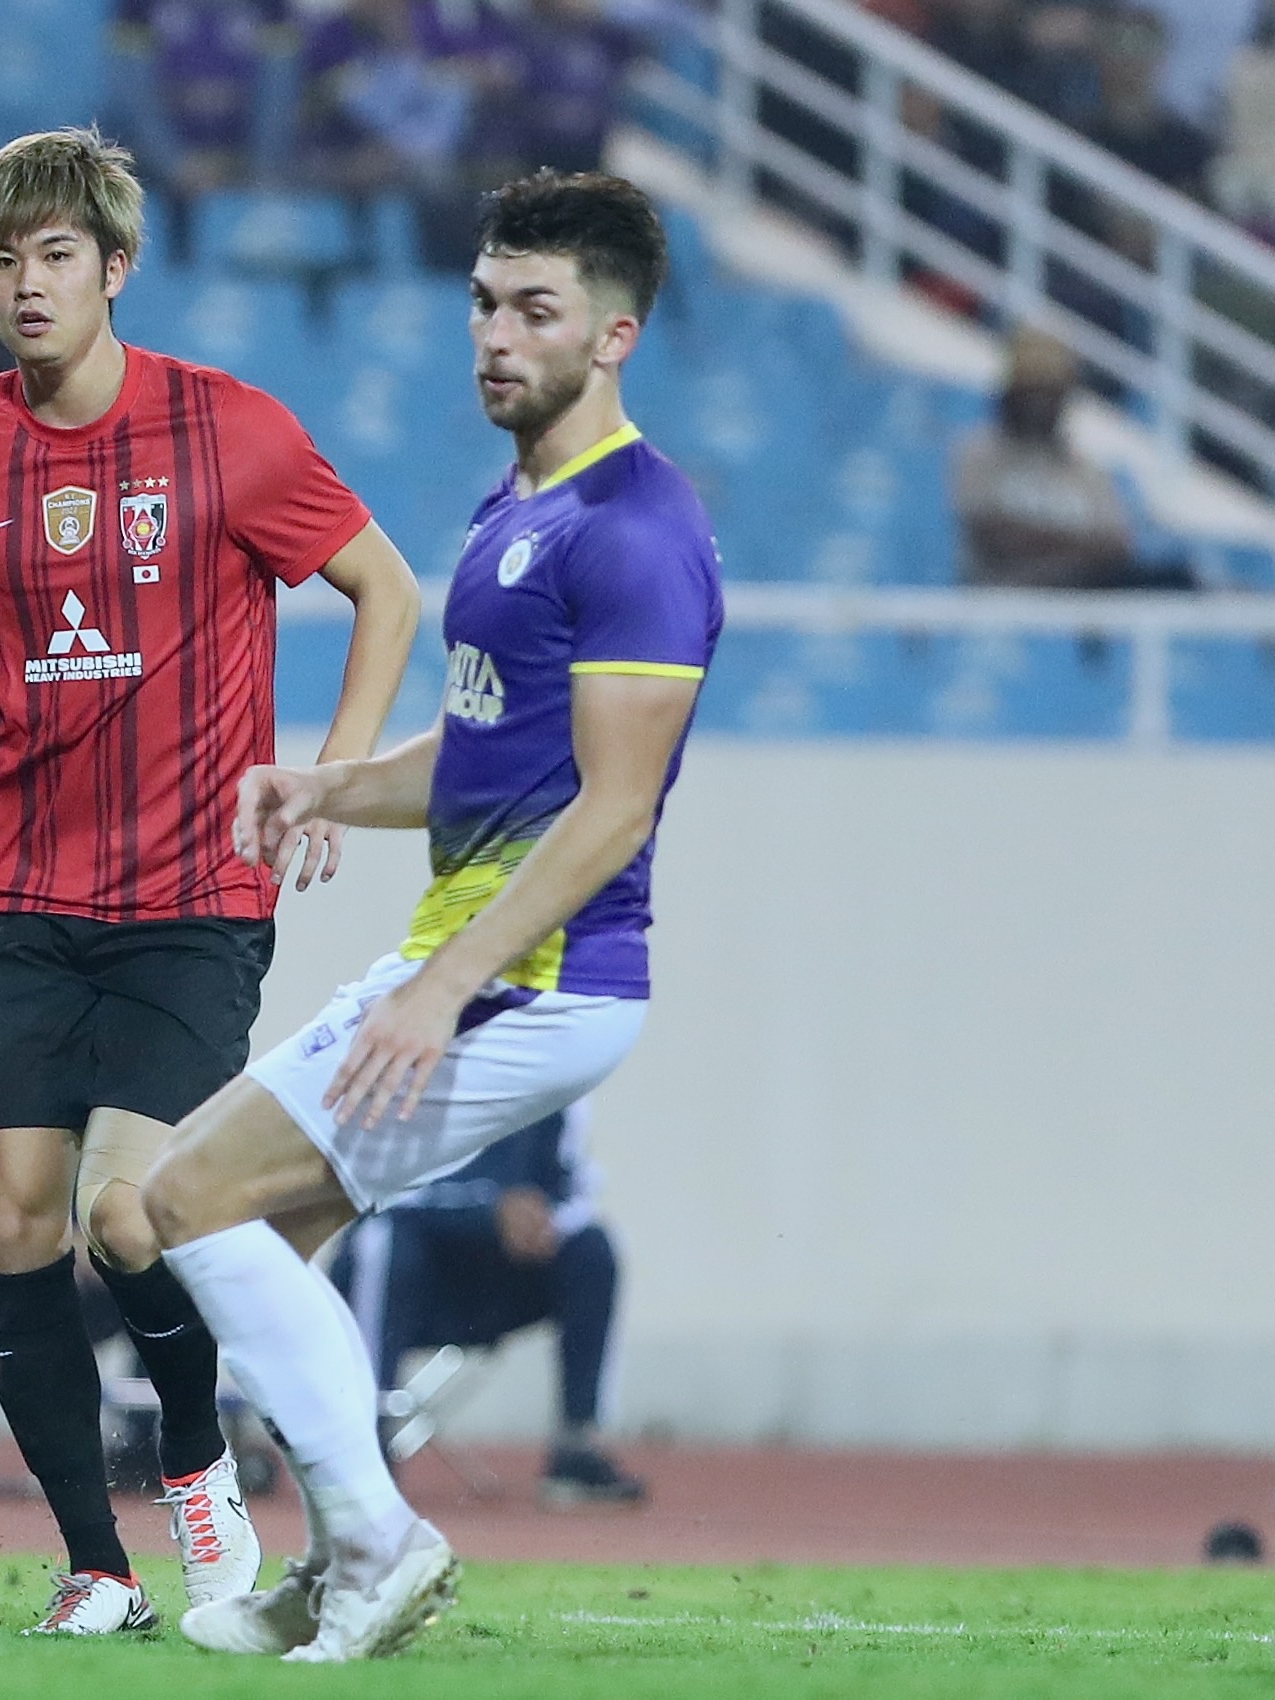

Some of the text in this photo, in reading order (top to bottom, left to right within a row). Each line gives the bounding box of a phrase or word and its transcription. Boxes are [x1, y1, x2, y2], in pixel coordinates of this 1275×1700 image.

[25, 652, 142, 673] MITSUBISHI
[25, 667, 142, 683] HEAVY INDUSTRIES
